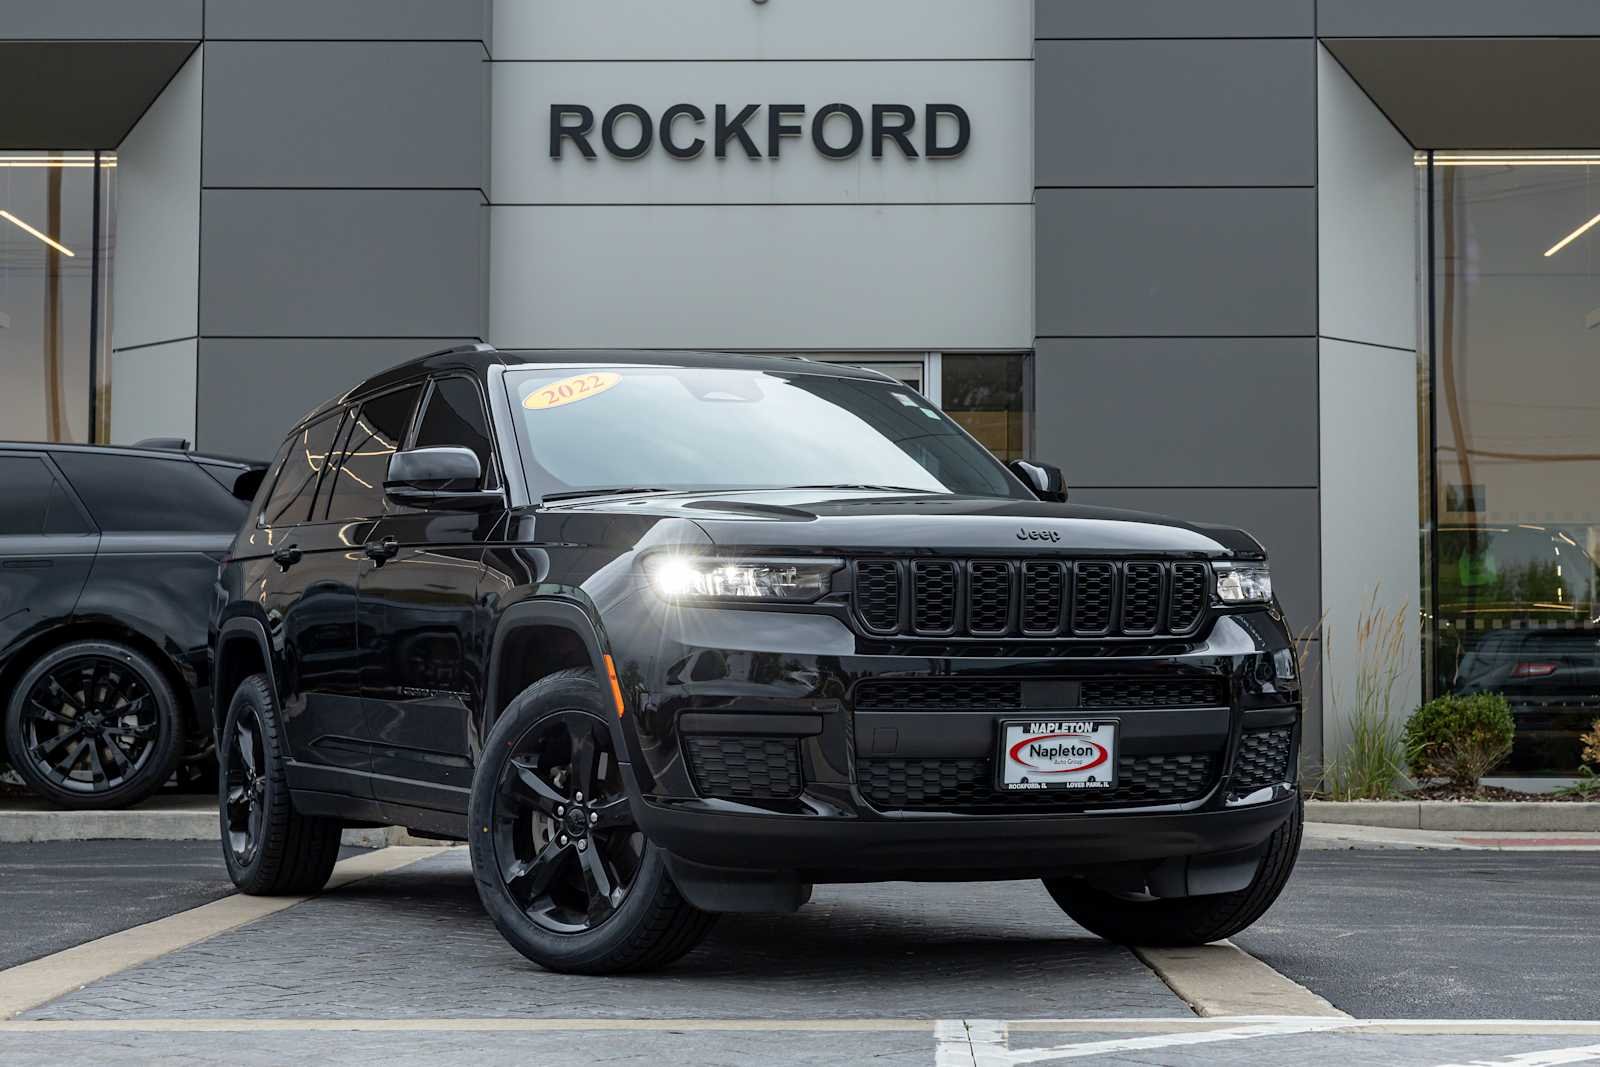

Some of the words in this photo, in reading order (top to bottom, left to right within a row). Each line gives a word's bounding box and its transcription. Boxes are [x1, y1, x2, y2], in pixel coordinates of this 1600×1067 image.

[549, 104, 971, 160] ROCKFORD
[542, 375, 605, 405] 2022
[1016, 528, 1061, 543] Jeep
[1030, 722, 1093, 733] NAPLETON
[1030, 744, 1093, 760] Napleton
